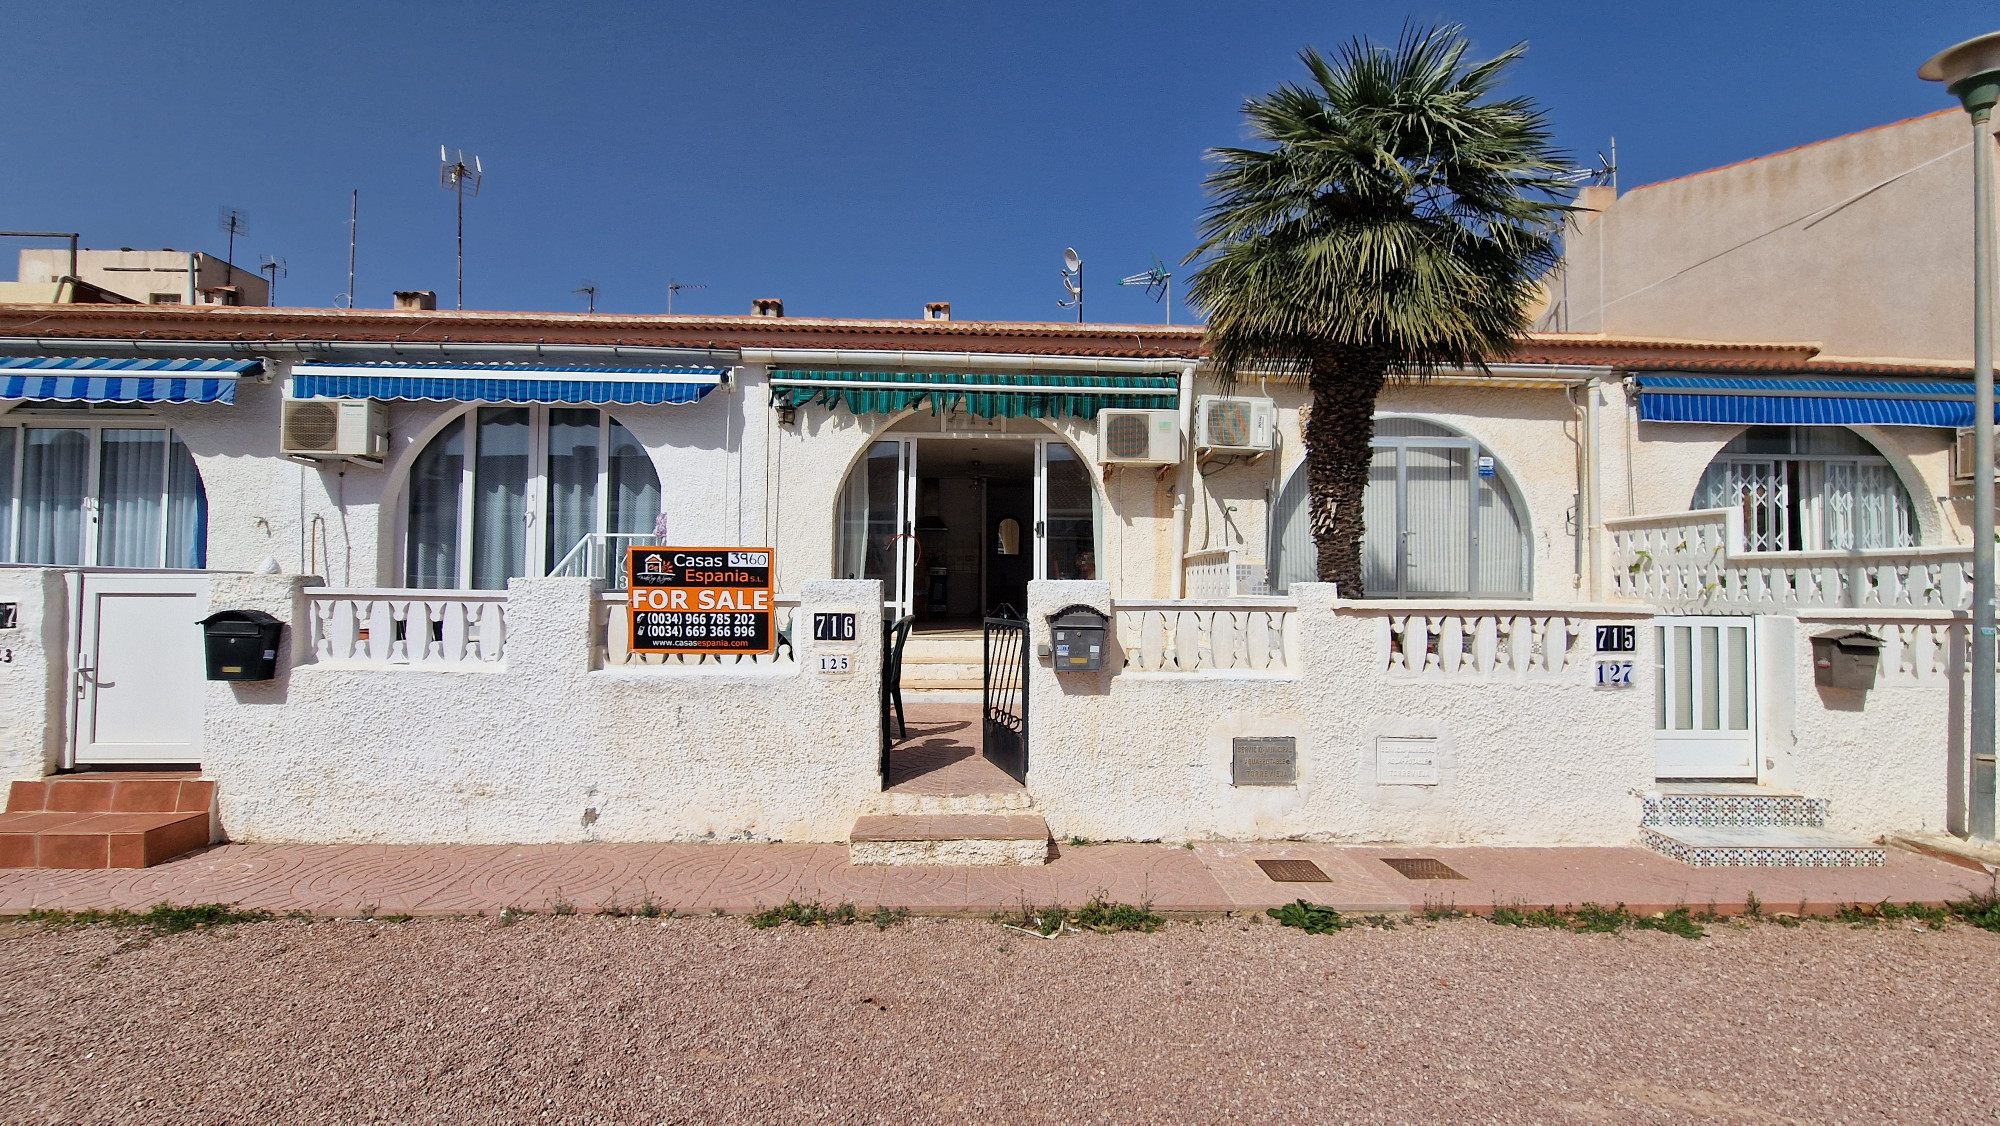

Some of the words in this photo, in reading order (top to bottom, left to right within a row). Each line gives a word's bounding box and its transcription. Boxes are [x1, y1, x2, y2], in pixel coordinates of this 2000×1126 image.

[674, 554, 723, 567] Casas
[730, 552, 767, 565] 3960
[685, 569, 749, 585] Espania
[632, 589, 690, 609] FOR
[698, 590, 769, 610] SALE
[647, 613, 683, 625] (0034)
[685, 613, 707, 625] 966
[709, 613, 731, 625] 785
[734, 613, 756, 625] 202
[647, 625, 683, 637] (0034)
[685, 625, 707, 637] 669
[709, 625, 731, 637] 366
[734, 625, 756, 637] 996
[816, 615, 853, 638] 716
[652, 640, 749, 648] www.casasespania.com
[1598, 627, 1634, 649] 715
[821, 657, 848, 670] 125
[1597, 664, 1633, 683] 127
